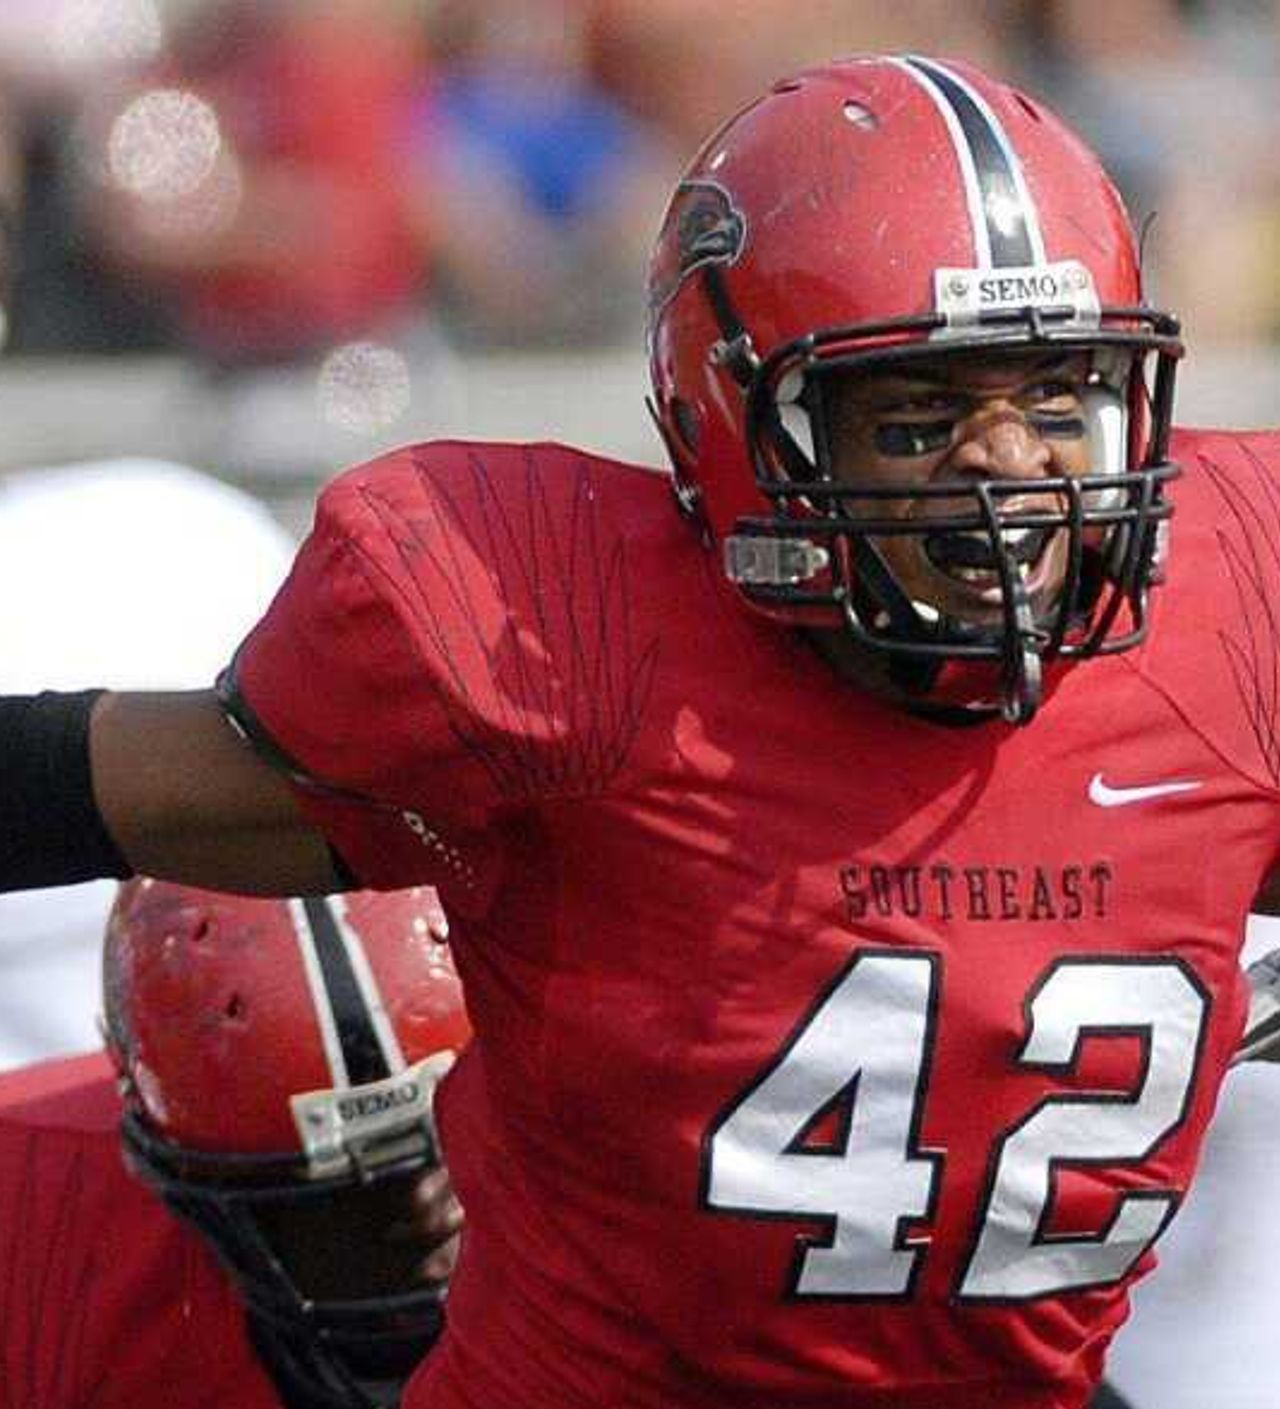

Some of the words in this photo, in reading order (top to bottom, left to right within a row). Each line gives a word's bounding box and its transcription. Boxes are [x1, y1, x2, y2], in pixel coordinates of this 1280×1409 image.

[978, 275, 1058, 303] SEMO
[837, 862, 1114, 922] SOUTHEAST
[336, 1082, 420, 1122] SEMO
[700, 945, 1212, 1306] 42
